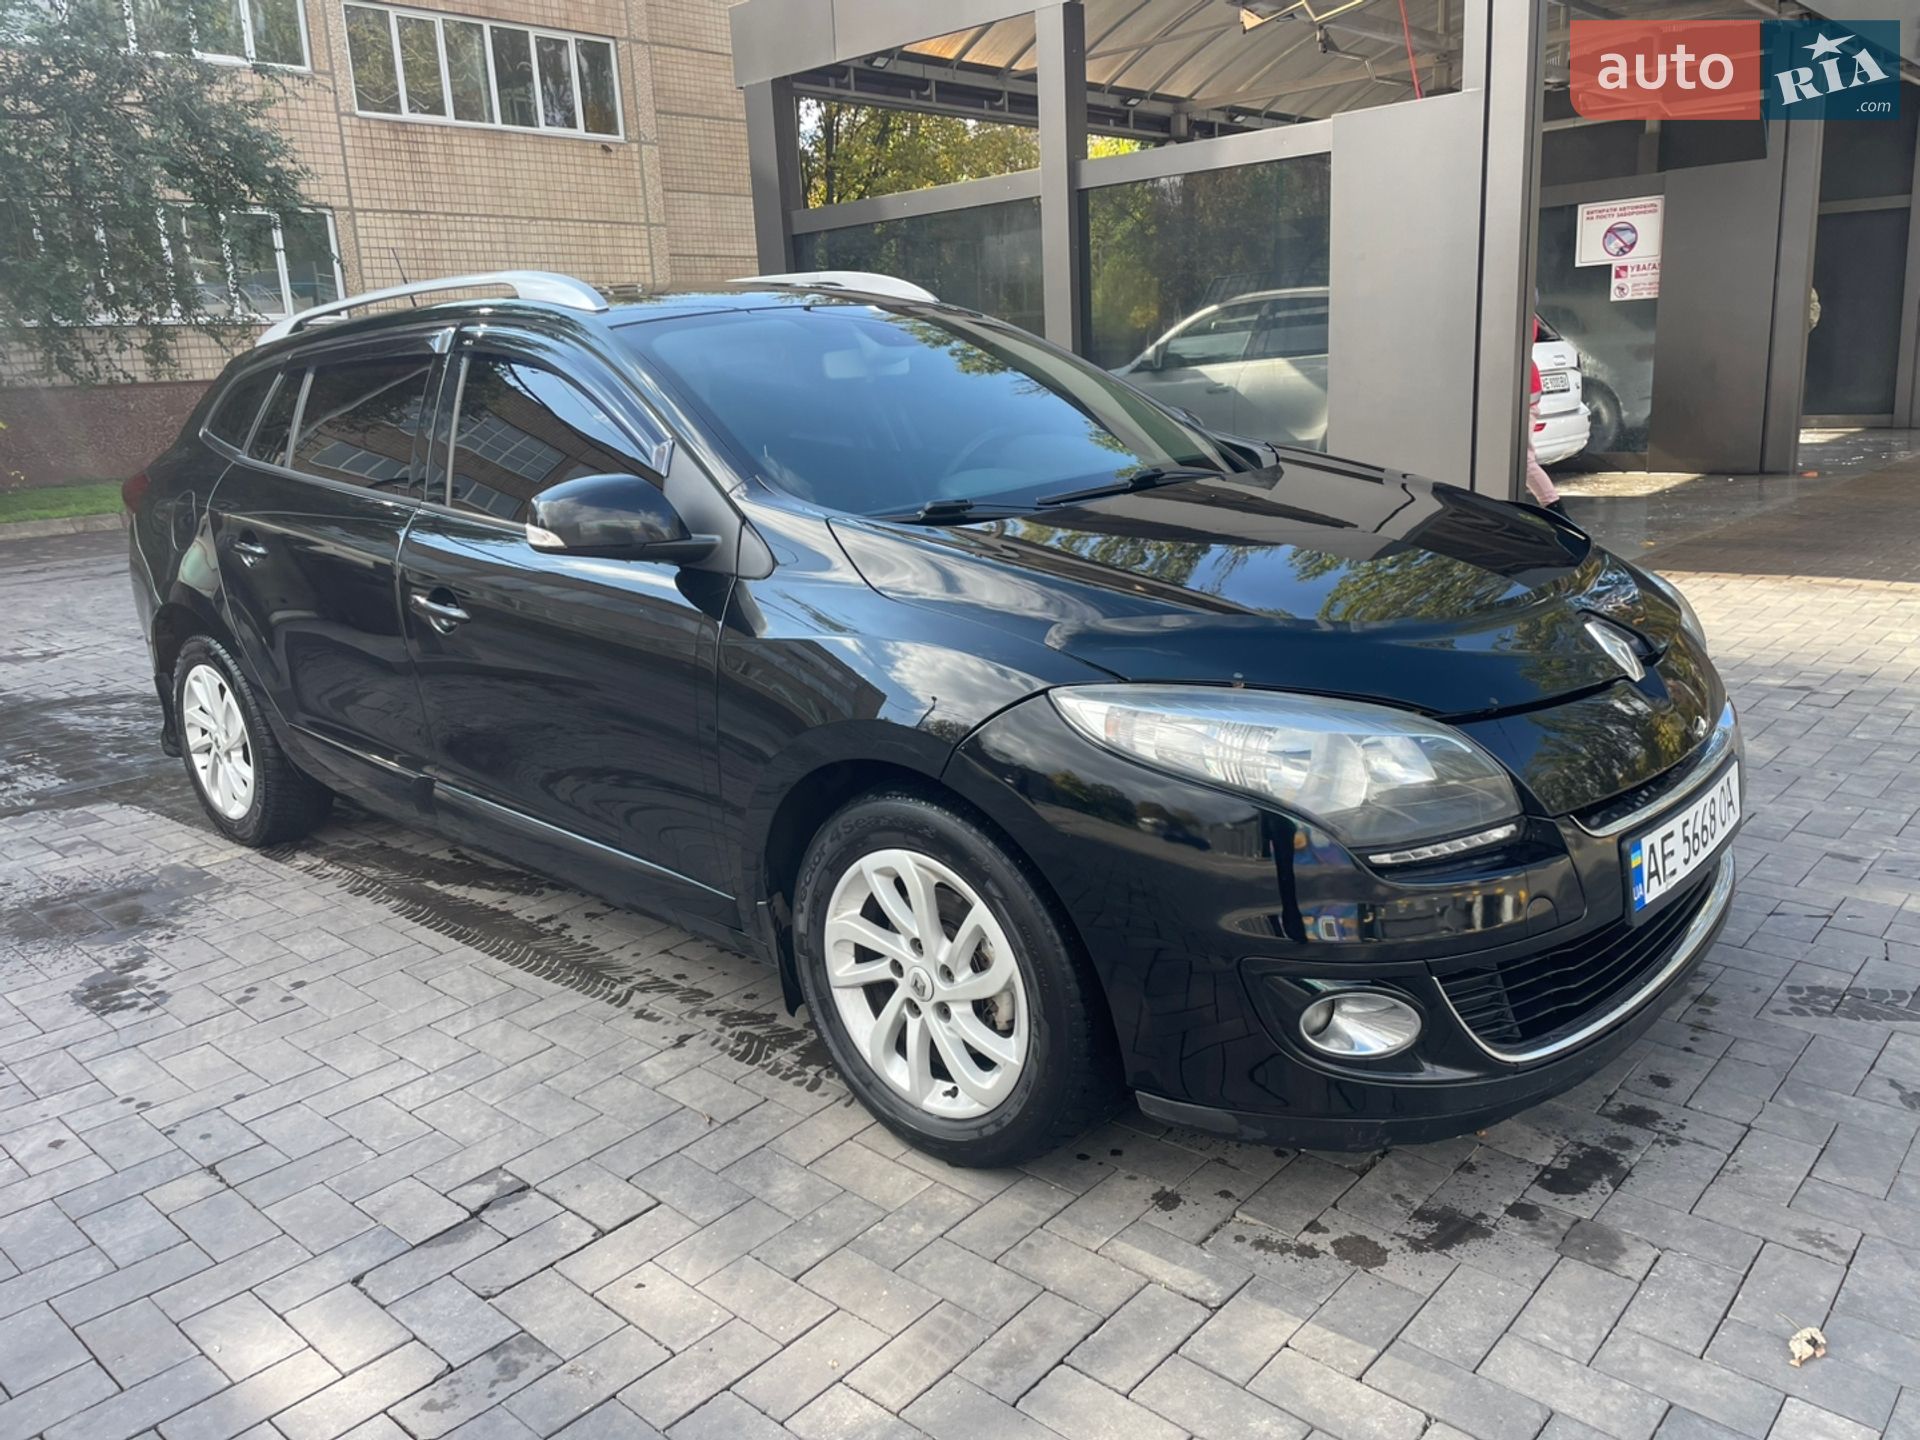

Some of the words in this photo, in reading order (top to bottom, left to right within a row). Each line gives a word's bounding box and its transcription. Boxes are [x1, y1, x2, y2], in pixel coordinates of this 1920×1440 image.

[1646, 830, 1676, 893] AE
[1682, 797, 1717, 865] 5668
[1719, 777, 1736, 827] OA
